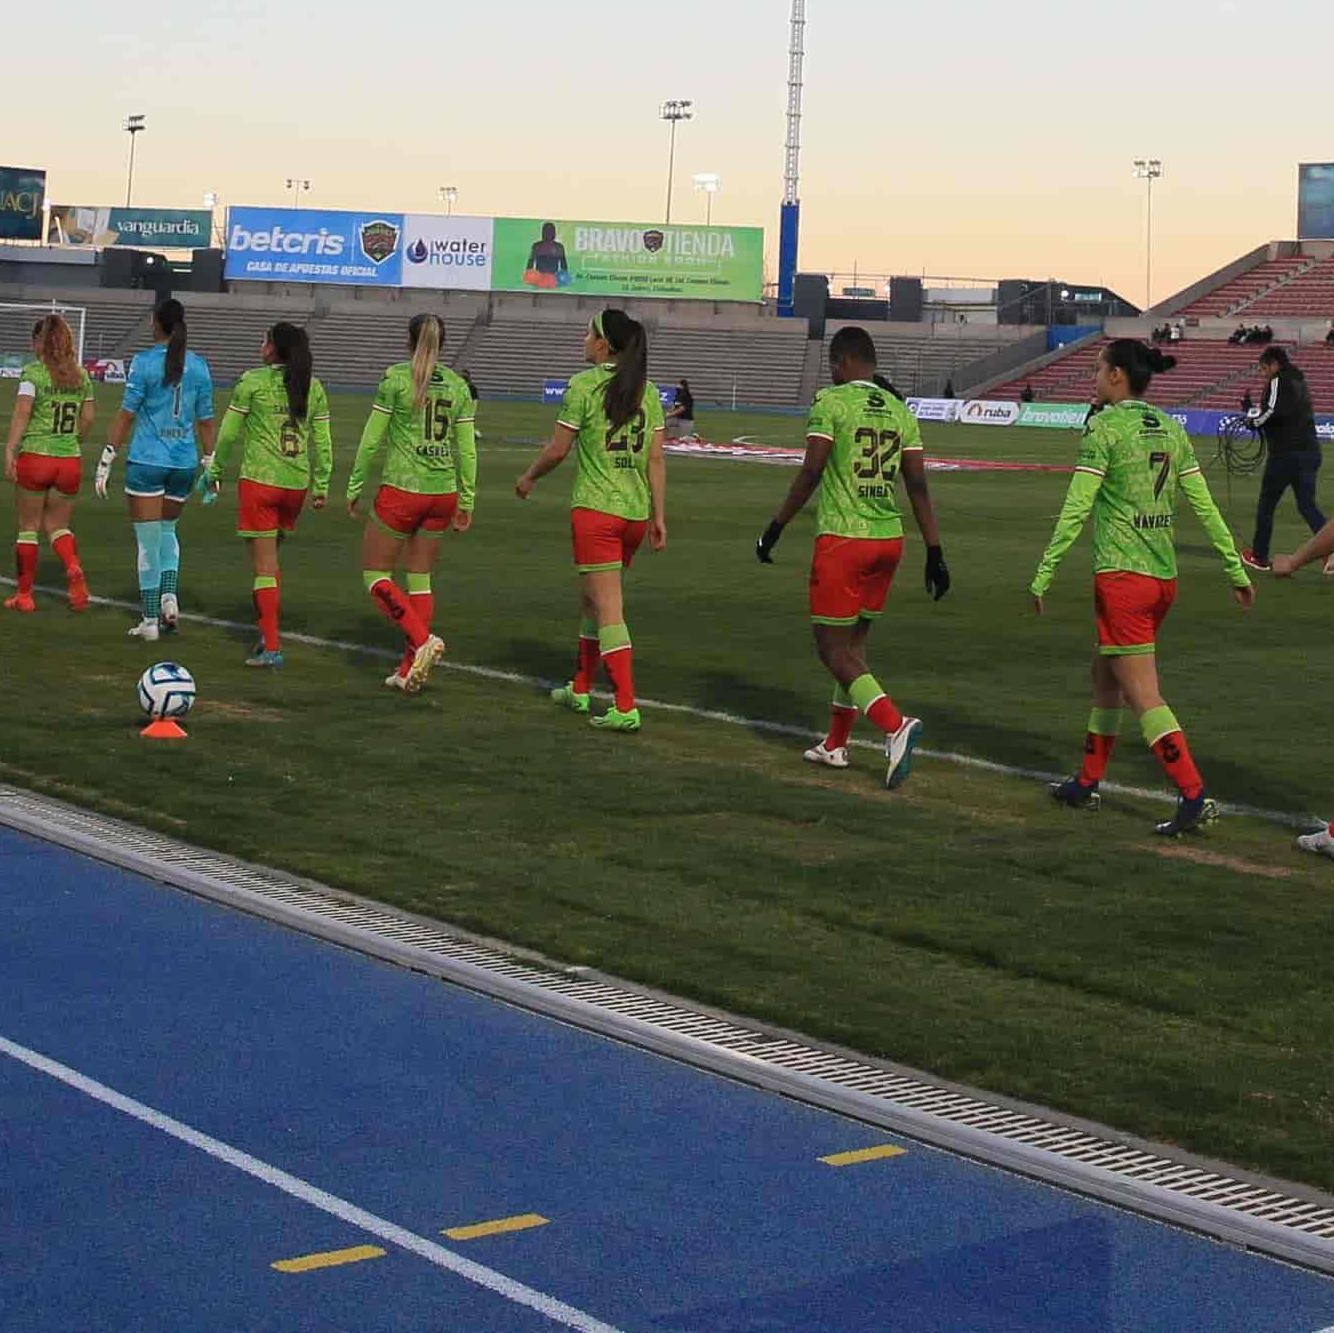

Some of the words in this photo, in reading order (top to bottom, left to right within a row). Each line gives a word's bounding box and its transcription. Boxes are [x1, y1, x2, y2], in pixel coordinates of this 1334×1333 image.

[117, 218, 199, 237] vanguardia
[229, 224, 345, 256] betcris
[430, 242, 486, 267] house
[433, 238, 486, 254] water
[666, 230, 735, 258] TIENDA
[422, 396, 453, 442] 15
[983, 406, 1012, 419] ruba
[853, 427, 902, 480] 32
[1148, 451, 1169, 503] 7
